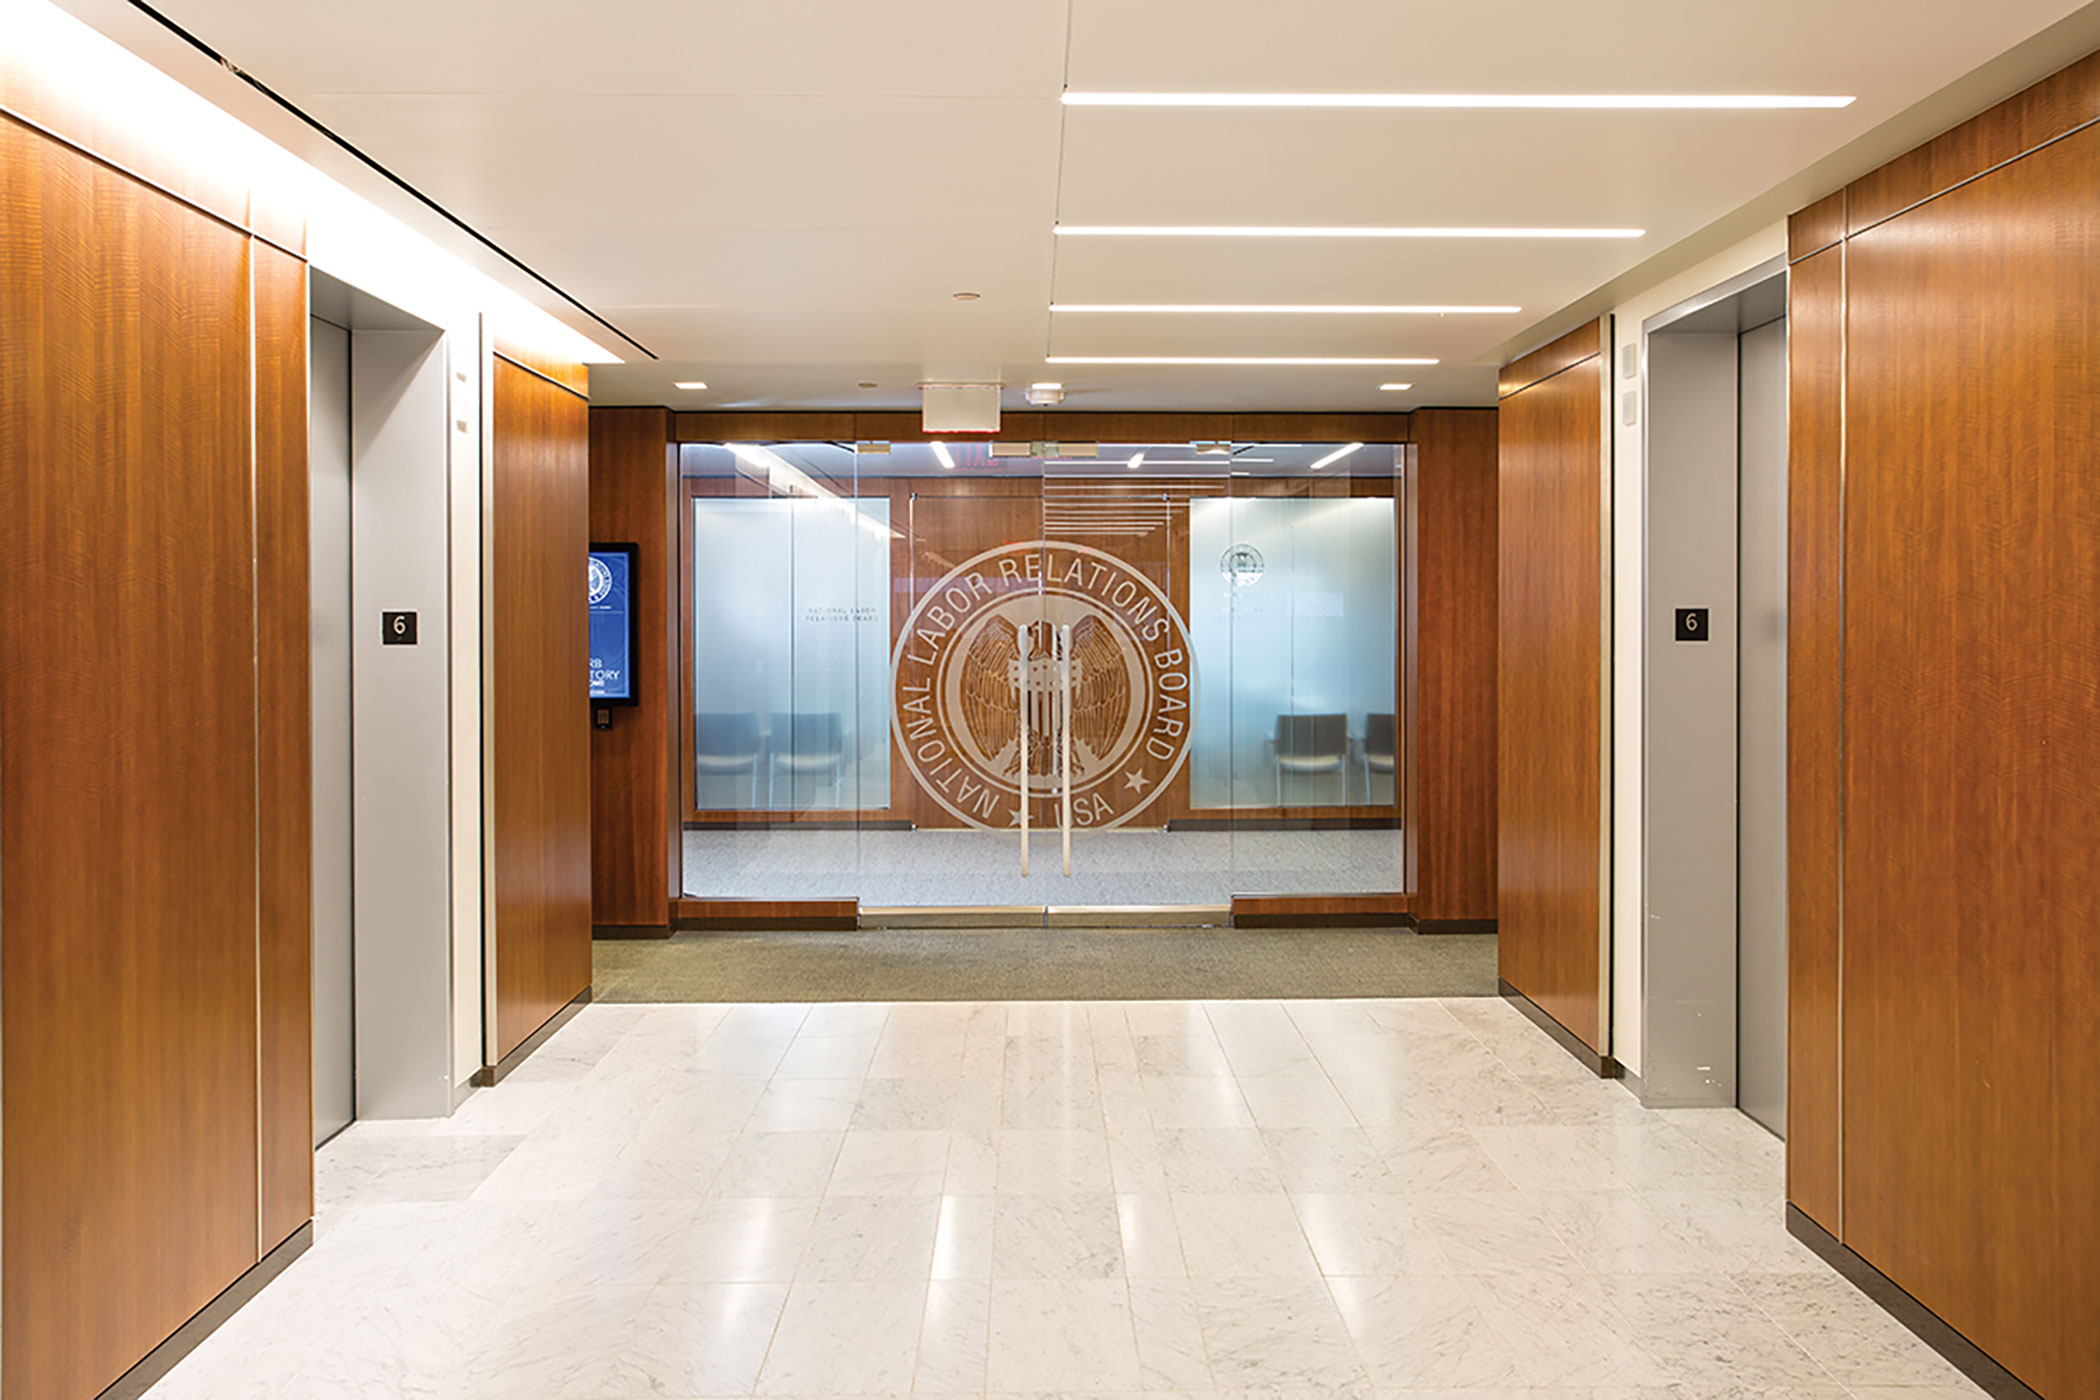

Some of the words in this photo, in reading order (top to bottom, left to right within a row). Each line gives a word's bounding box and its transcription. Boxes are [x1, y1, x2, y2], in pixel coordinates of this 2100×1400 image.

[393, 615, 406, 635] 6
[906, 571, 993, 667] LABOR
[998, 554, 1170, 642] RELATIONS
[1686, 612, 1698, 631] 6
[902, 677, 1000, 819] NATIONAL
[1147, 649, 1188, 762] BOARD
